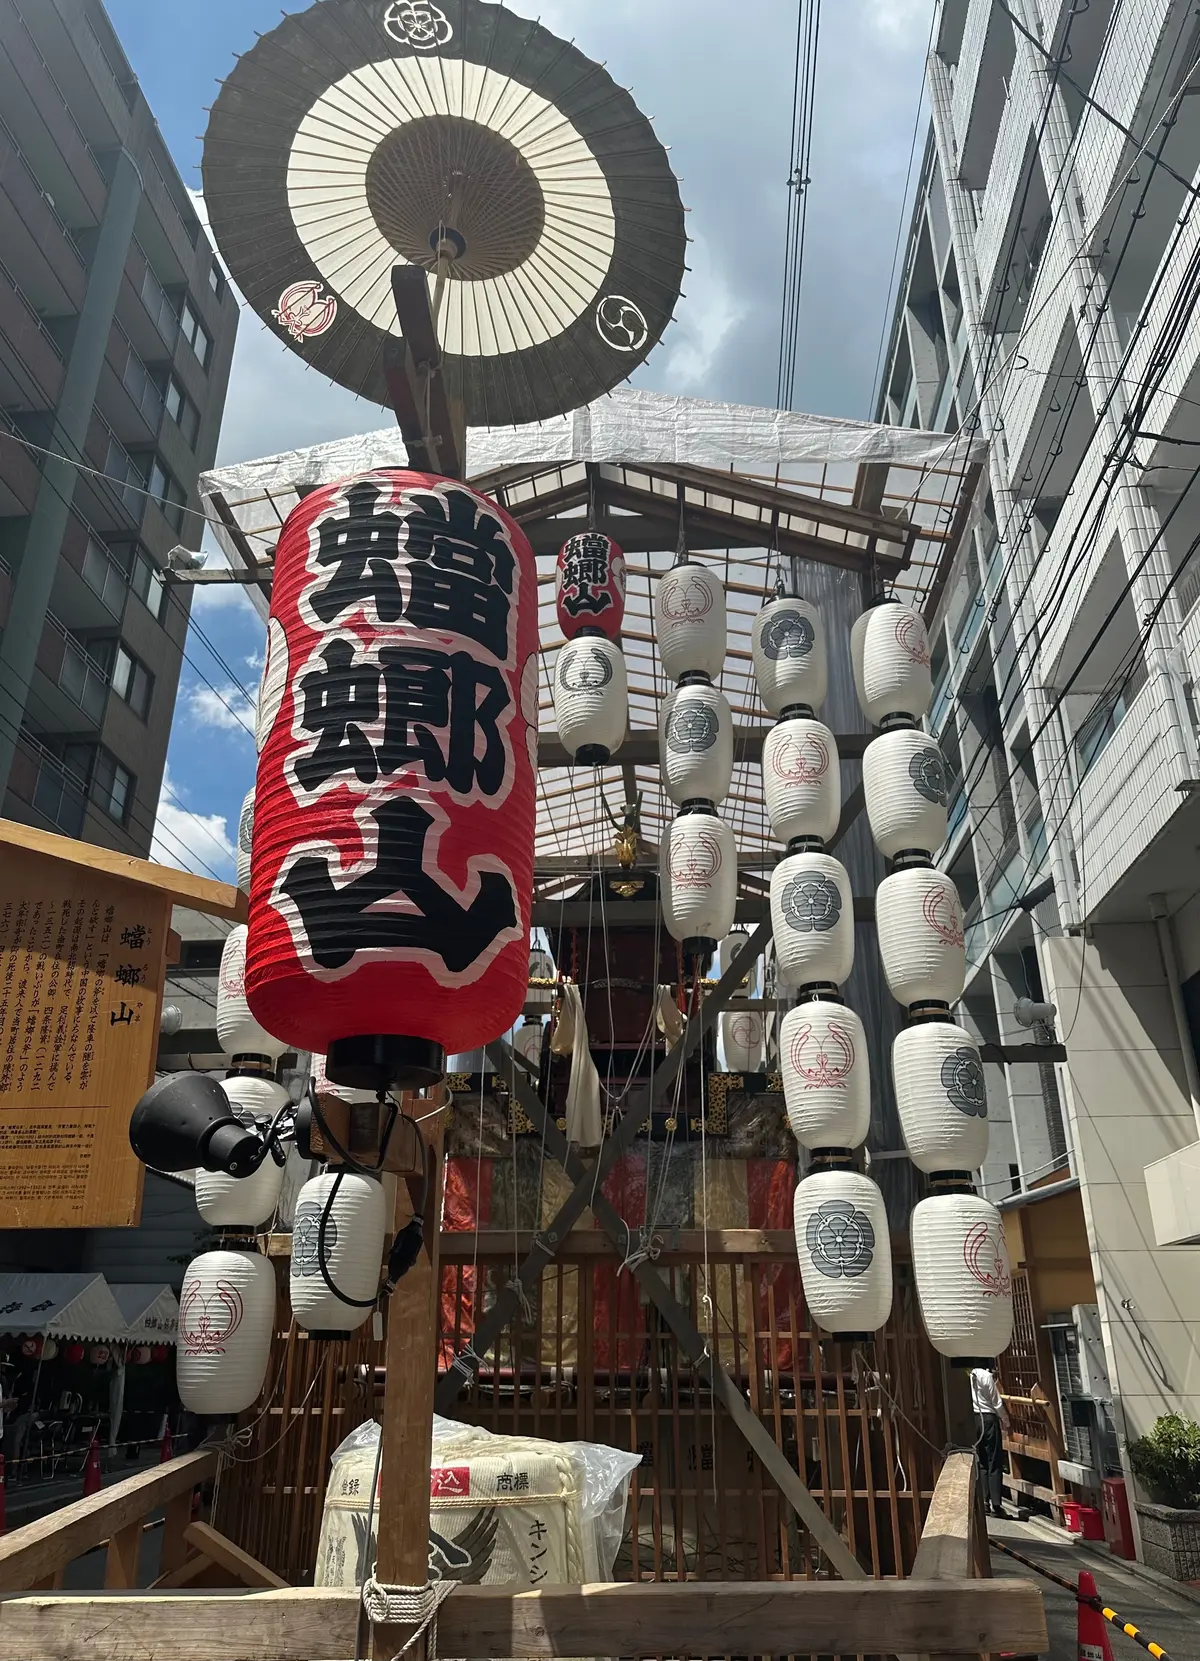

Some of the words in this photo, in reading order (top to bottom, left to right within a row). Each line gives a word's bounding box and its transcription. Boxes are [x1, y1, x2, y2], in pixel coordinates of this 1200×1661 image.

[562, 533, 612, 616] 蟷螂山
[279, 480, 517, 974] 蟷螂山
[110, 924, 146, 1027] 蟷螂山
[496, 1472, 530, 1492] 商標
[528, 1520, 548, 1585] キンシ
